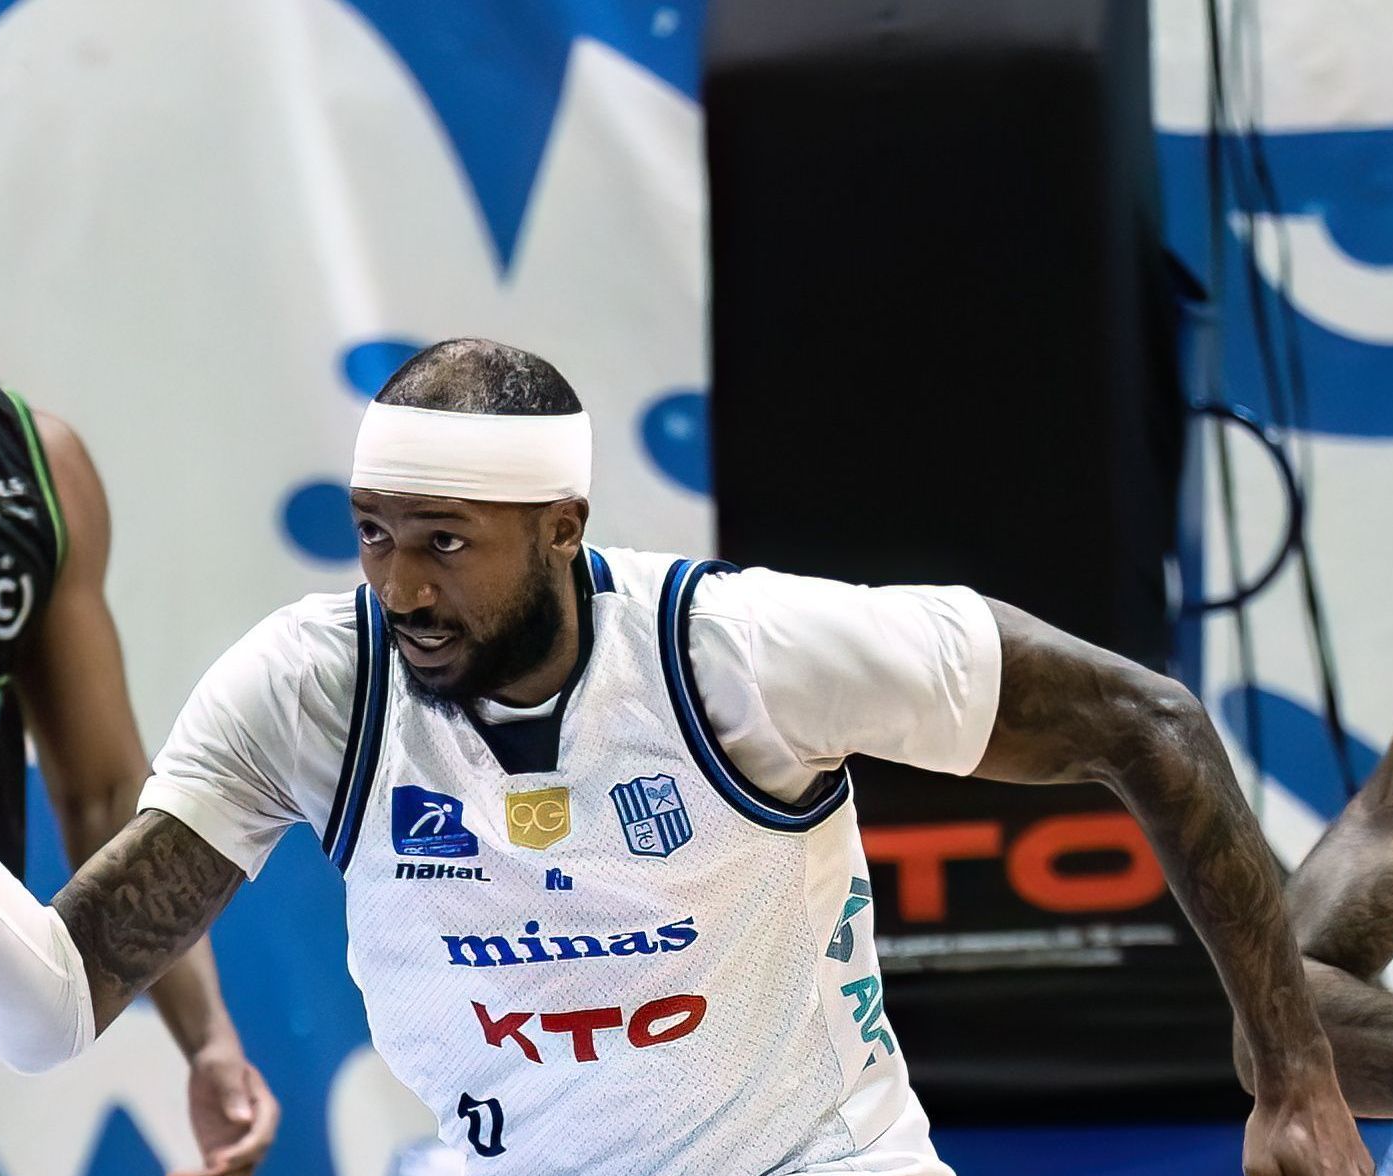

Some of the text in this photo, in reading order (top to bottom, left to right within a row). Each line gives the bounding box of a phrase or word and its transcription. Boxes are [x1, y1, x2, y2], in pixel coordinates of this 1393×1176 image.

[861, 811, 1166, 922] TO
[440, 916, 699, 967] minas
[469, 993, 708, 1065] KTO
